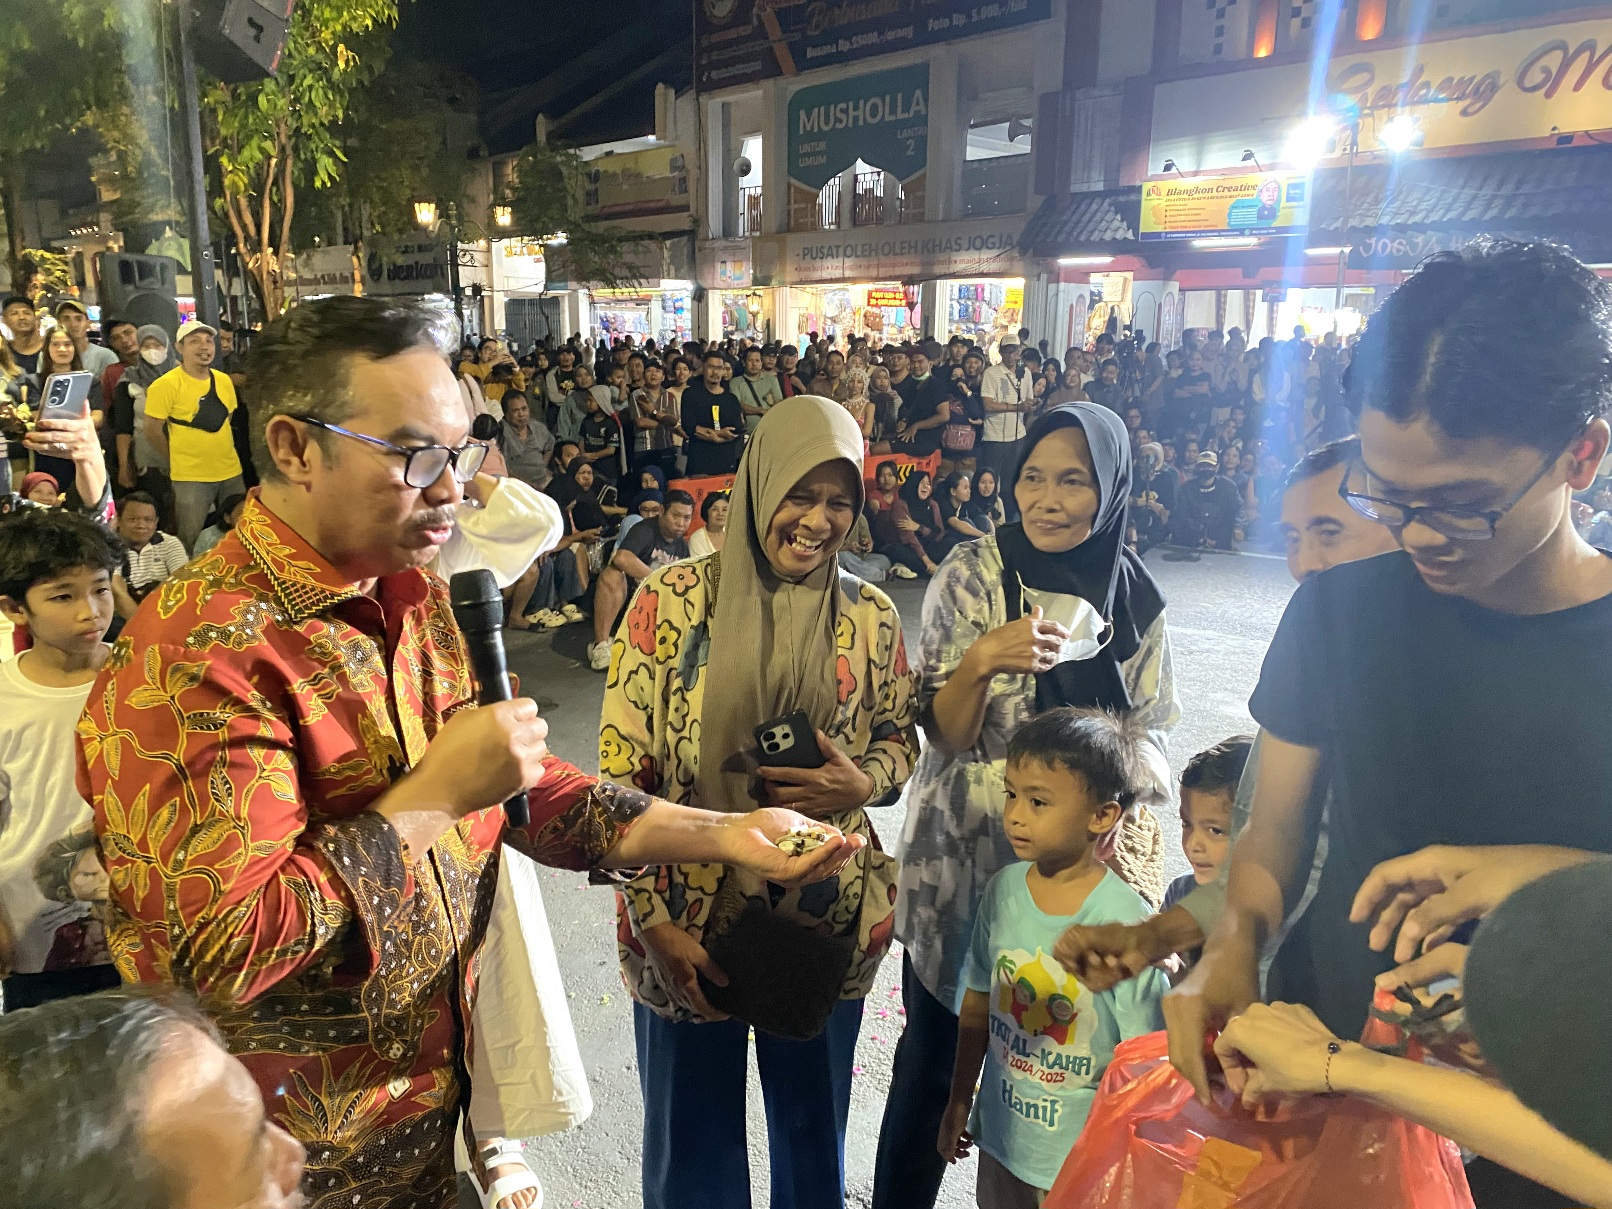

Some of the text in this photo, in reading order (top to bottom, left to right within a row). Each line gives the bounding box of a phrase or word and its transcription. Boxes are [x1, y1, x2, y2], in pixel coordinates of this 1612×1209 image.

[799, 88, 927, 136] MUSHOLLA
[799, 140, 827, 154] UNTUK
[905, 139, 916, 156] 2
[799, 155, 827, 168] UMUM
[1166, 183, 1259, 199] Blangkon Creative
[803, 233, 1015, 261] PUSAT OLEH OLEH KHAS JOGJA
[1010, 1055, 1066, 1083] 2024/2025
[1011, 1034, 1092, 1076] AL-KAHFI
[1002, 1078, 1059, 1128] Hanif
